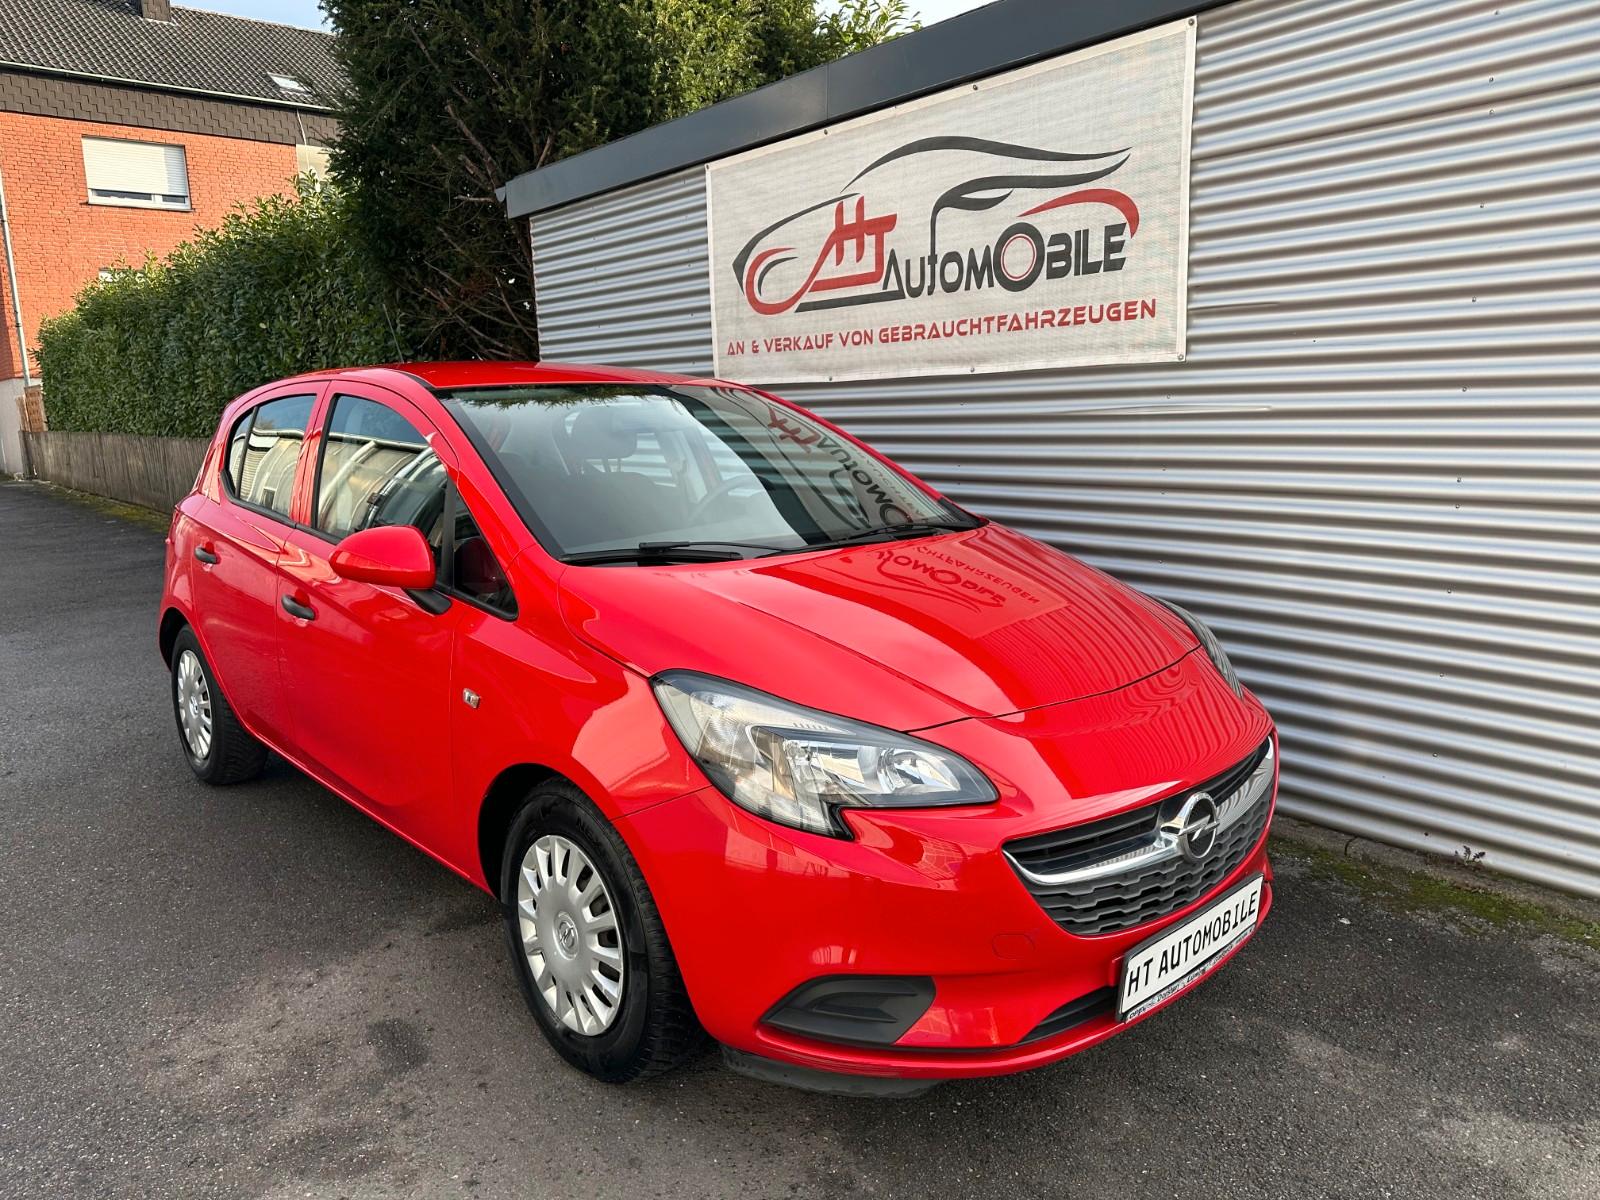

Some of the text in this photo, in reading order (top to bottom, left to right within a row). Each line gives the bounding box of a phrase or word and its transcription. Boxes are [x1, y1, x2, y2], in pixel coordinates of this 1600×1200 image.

[820, 195, 898, 293] HT
[727, 298, 1157, 356] AN & VERKAUF VON GEBRAUCHTFAHRZEUGEN
[1127, 890, 1258, 997] HT AUTOMOBILE
